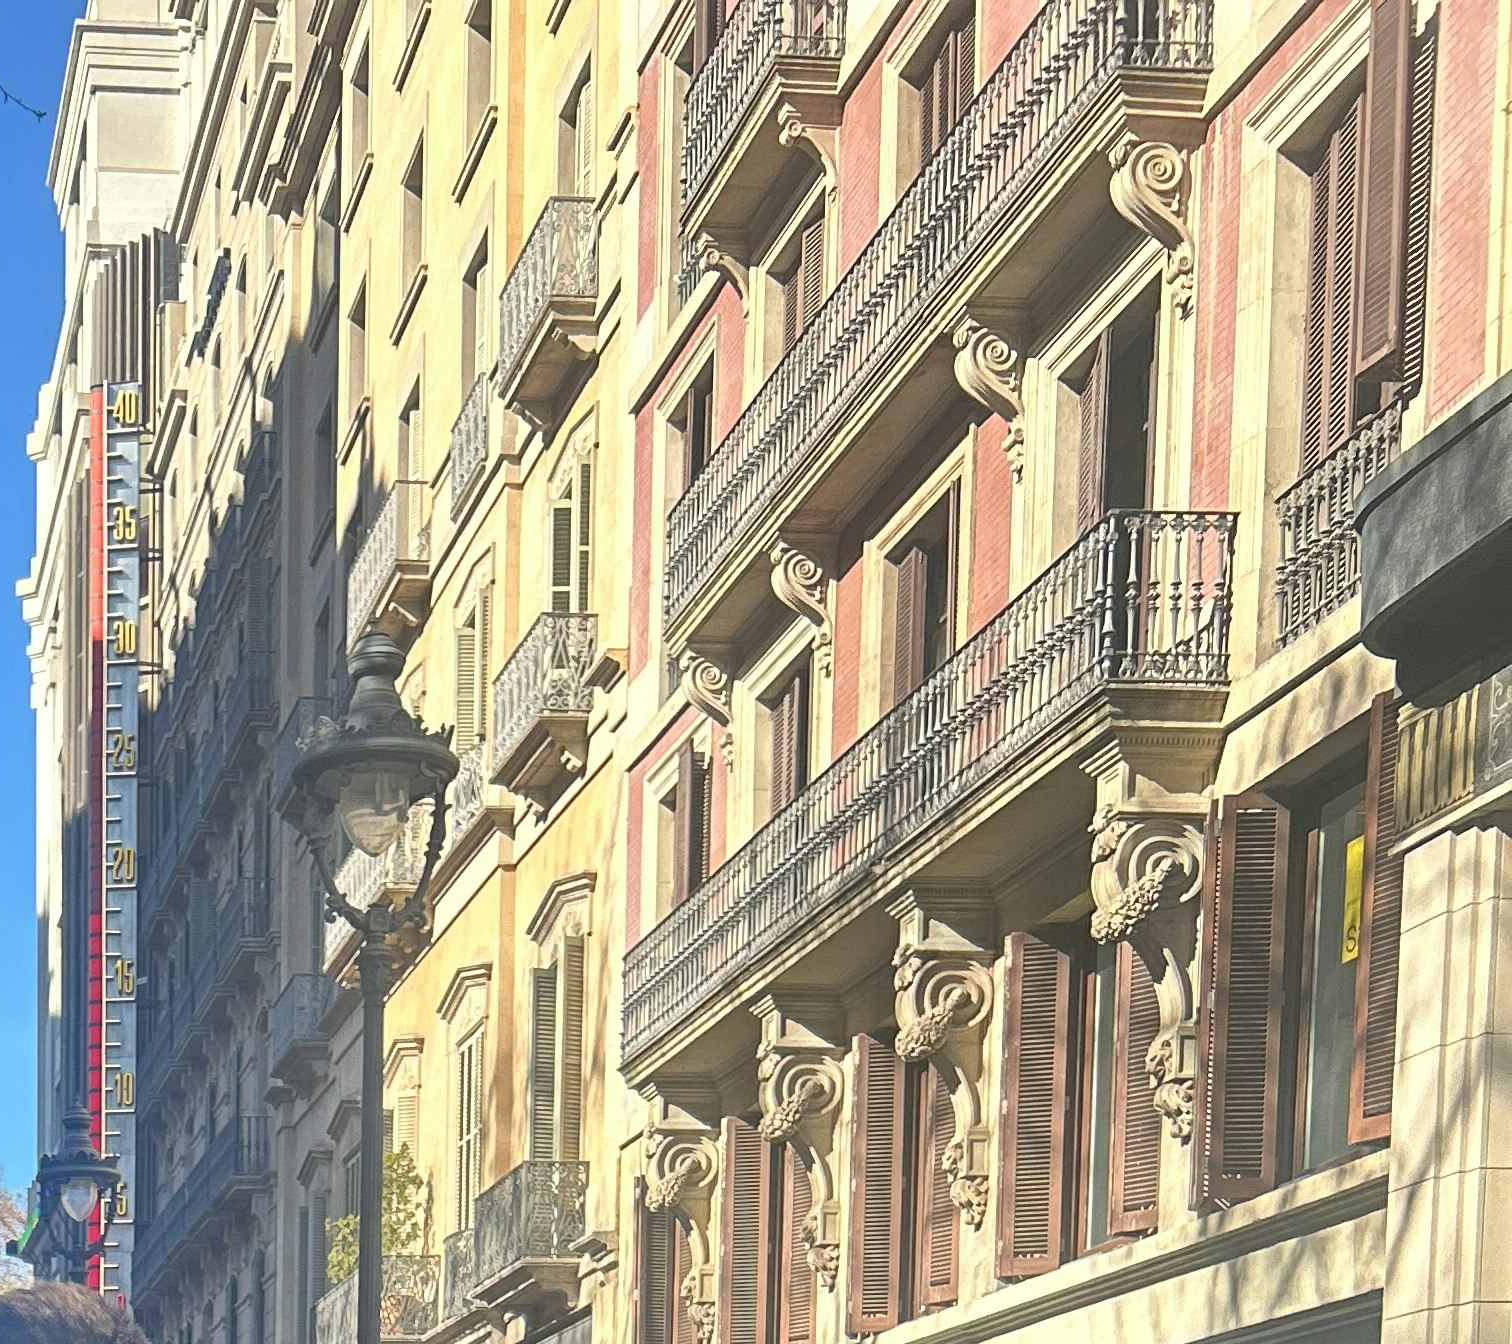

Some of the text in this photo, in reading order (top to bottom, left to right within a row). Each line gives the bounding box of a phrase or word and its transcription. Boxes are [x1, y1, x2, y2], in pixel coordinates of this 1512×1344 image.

[113, 389, 136, 424] 40
[113, 506, 136, 541] 35
[113, 621, 136, 655] 30
[112, 734, 135, 769] 25
[112, 847, 135, 883] 20
[114, 959, 134, 995] 15
[114, 1072, 134, 1106] 10
[116, 1183, 128, 1216] 5
